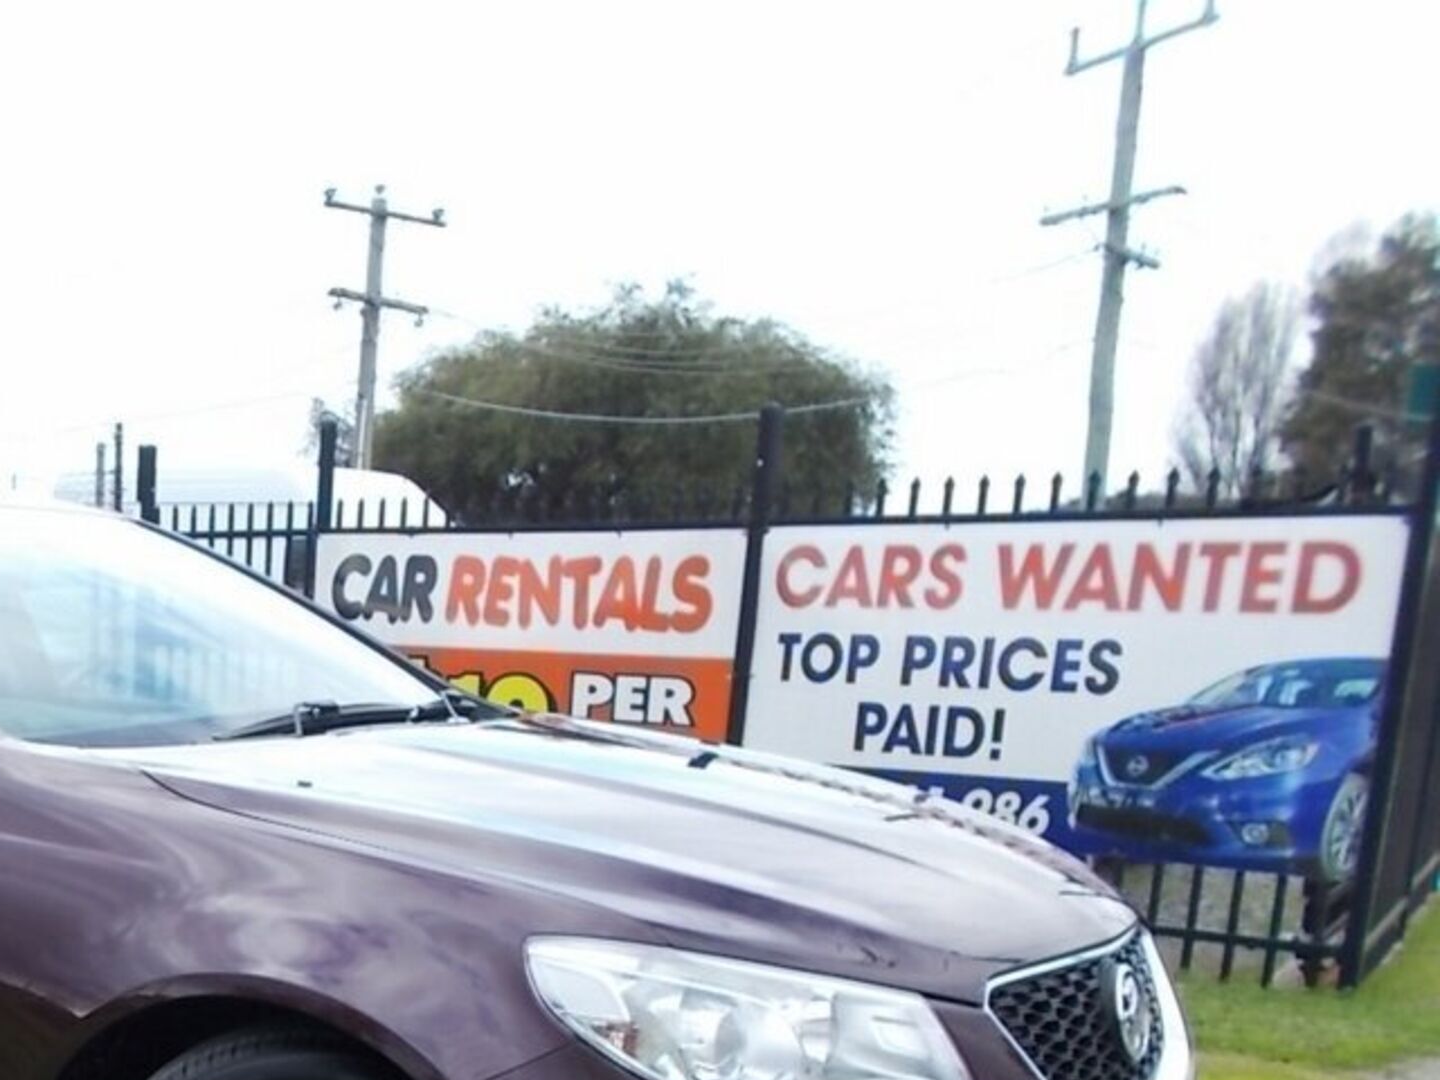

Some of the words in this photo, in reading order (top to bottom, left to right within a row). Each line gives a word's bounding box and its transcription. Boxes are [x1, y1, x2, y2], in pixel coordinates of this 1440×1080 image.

[332, 553, 439, 625] CAR
[445, 554, 713, 633] RENTALS
[775, 544, 968, 610] CARS
[996, 541, 1364, 614] WANTED
[777, 632, 880, 684] TOP
[899, 635, 1124, 695] PRICES
[570, 669, 694, 727] PER
[852, 701, 1006, 760] PAID!
